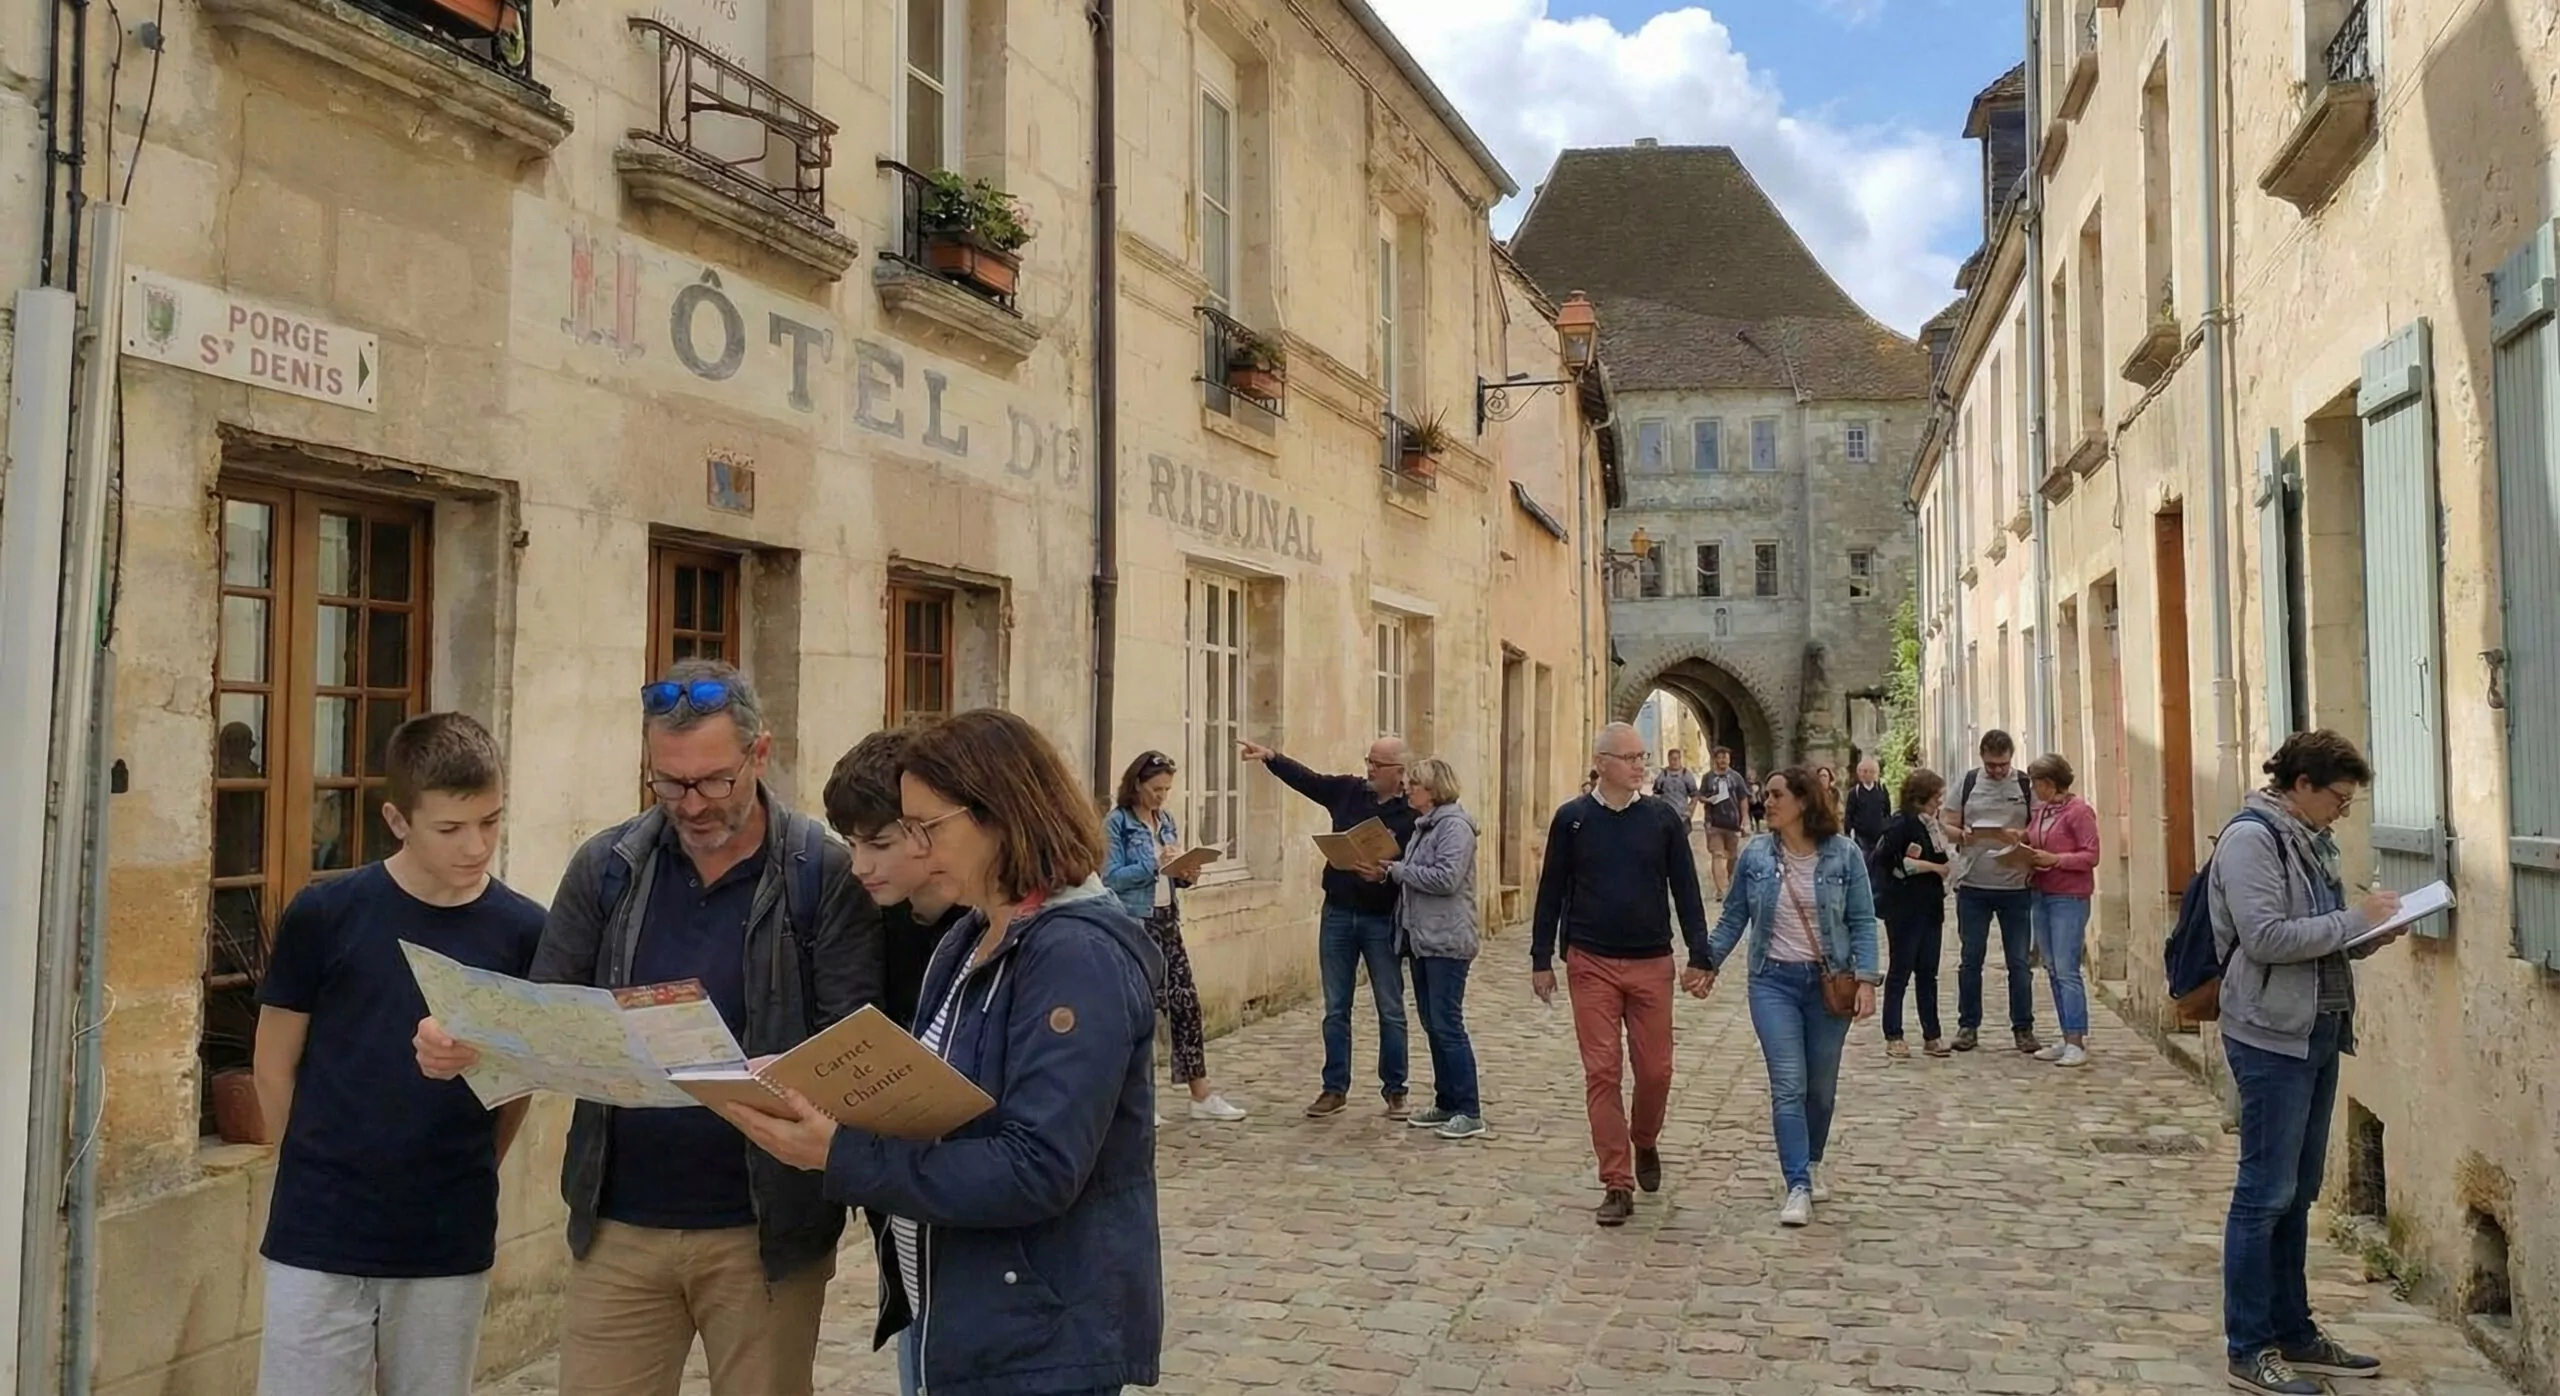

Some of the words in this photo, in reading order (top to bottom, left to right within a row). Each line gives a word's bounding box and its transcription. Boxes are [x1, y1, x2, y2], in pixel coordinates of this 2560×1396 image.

[229, 304, 329, 358] PORGE
[250, 347, 343, 396] DENIS
[1003, 404, 1081, 491] DU
[1148, 452, 1322, 566] RIBUNAL
[813, 1038, 875, 1079] Carnet
[852, 1061, 875, 1080] de
[843, 1062, 915, 1108] Chantier
